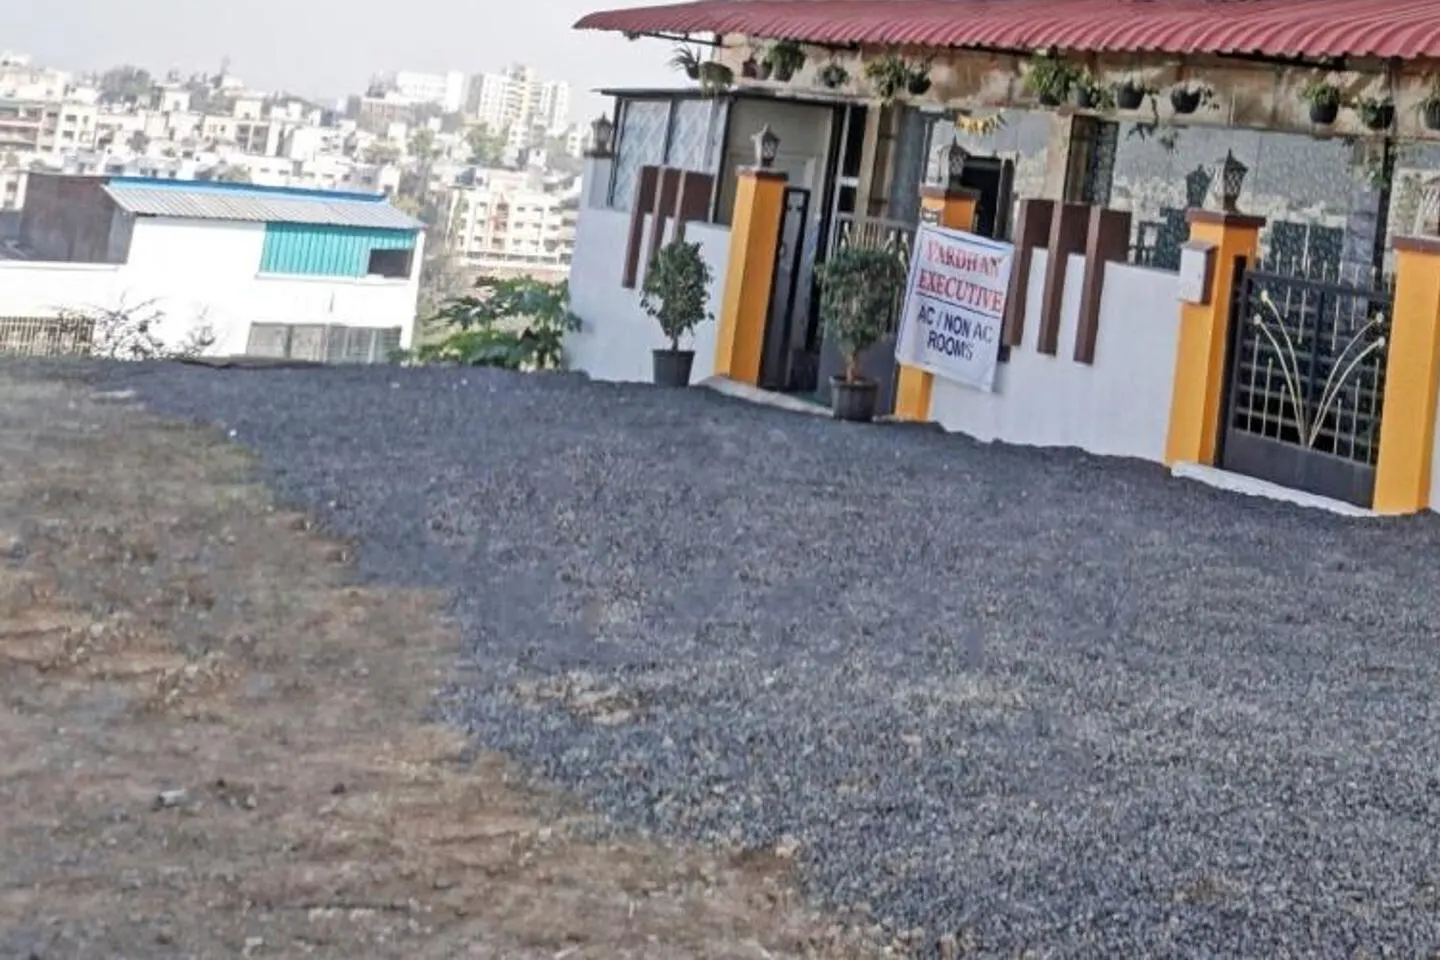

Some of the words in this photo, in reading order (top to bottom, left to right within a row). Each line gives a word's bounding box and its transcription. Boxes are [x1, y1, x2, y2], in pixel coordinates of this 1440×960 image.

[926, 239, 1003, 279] VARDHAN
[918, 268, 1004, 313] EXECUTIVE
[917, 304, 936, 326] AC
[943, 311, 972, 338] NON
[972, 323, 994, 344] AC
[926, 330, 974, 361] ROOMS
